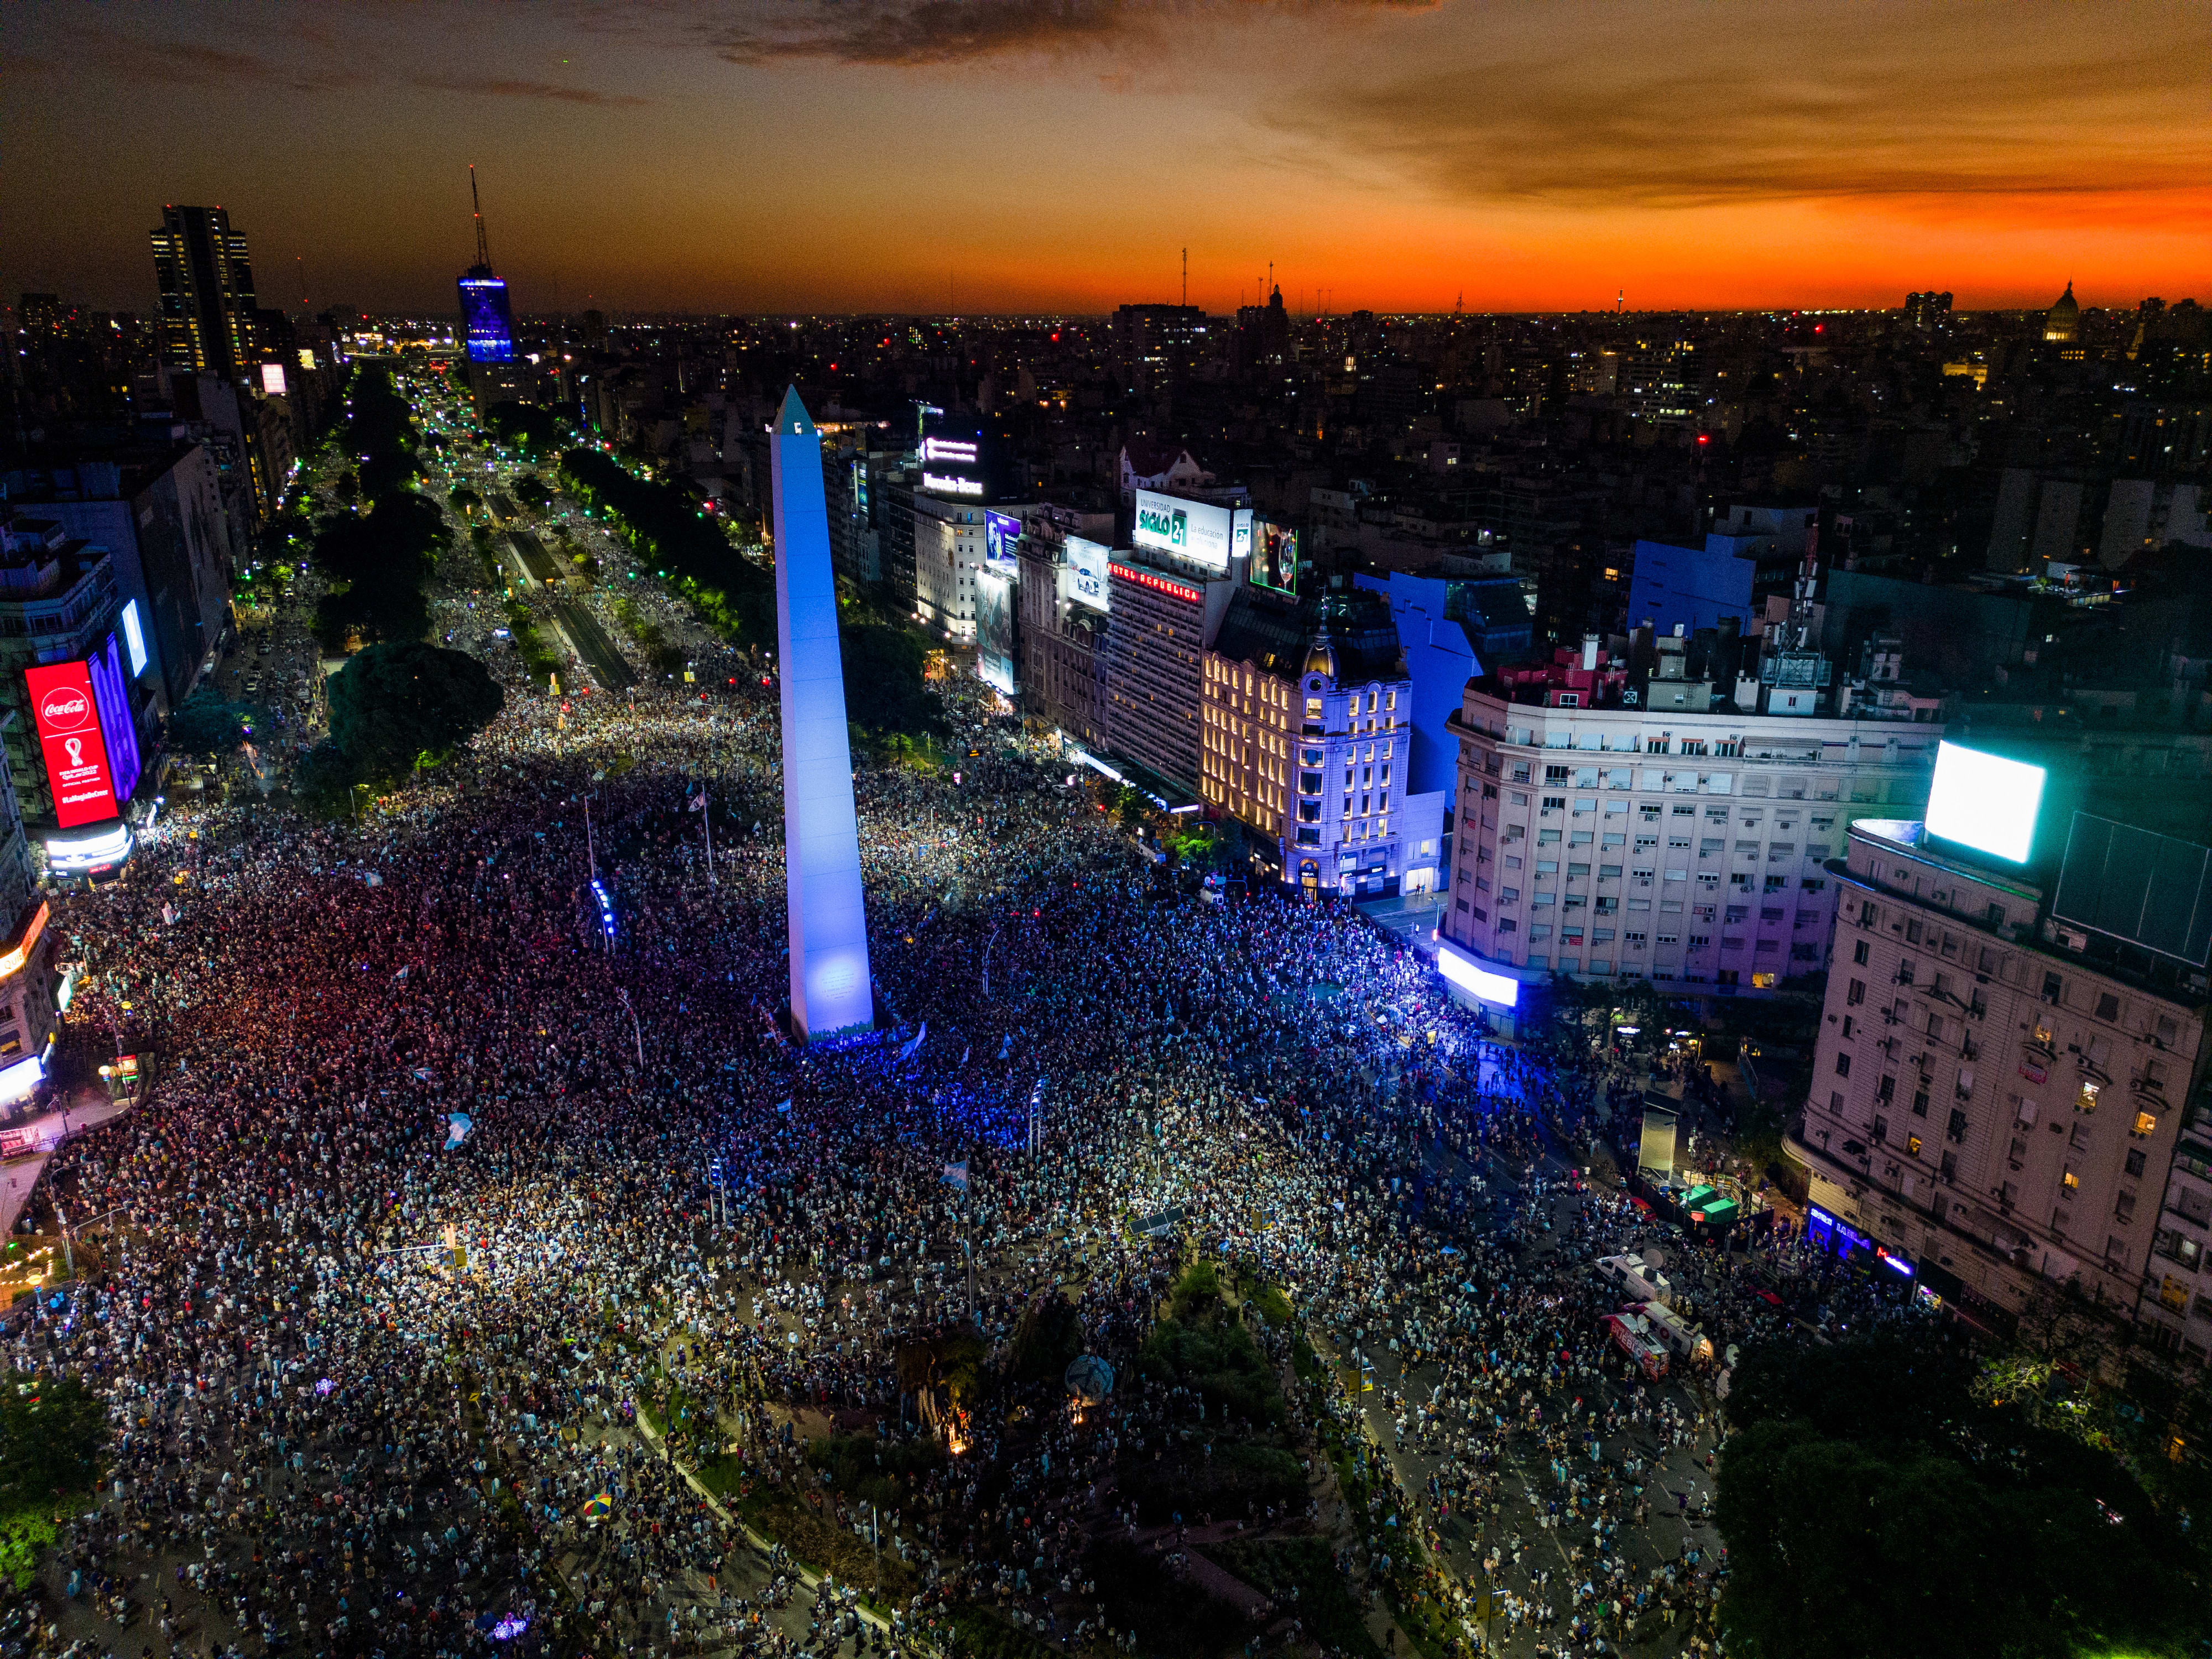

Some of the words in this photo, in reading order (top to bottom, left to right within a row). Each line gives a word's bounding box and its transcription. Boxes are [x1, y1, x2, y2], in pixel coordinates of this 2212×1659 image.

[1140, 499, 1170, 513] UNIVERSIDAD
[1139, 510, 1170, 536] SIGLO
[1173, 521, 1184, 546] 21
[1191, 524, 1197, 533] La
[1198, 526, 1223, 540] educación
[1237, 531, 1248, 542] 21
[1108, 563, 1135, 578] HOTEL
[1140, 574, 1197, 600] REPUBLICA
[62, 790, 108, 804] #LaMagiaDeCreer
[1611, 1324, 1642, 1358] PUEBLO
